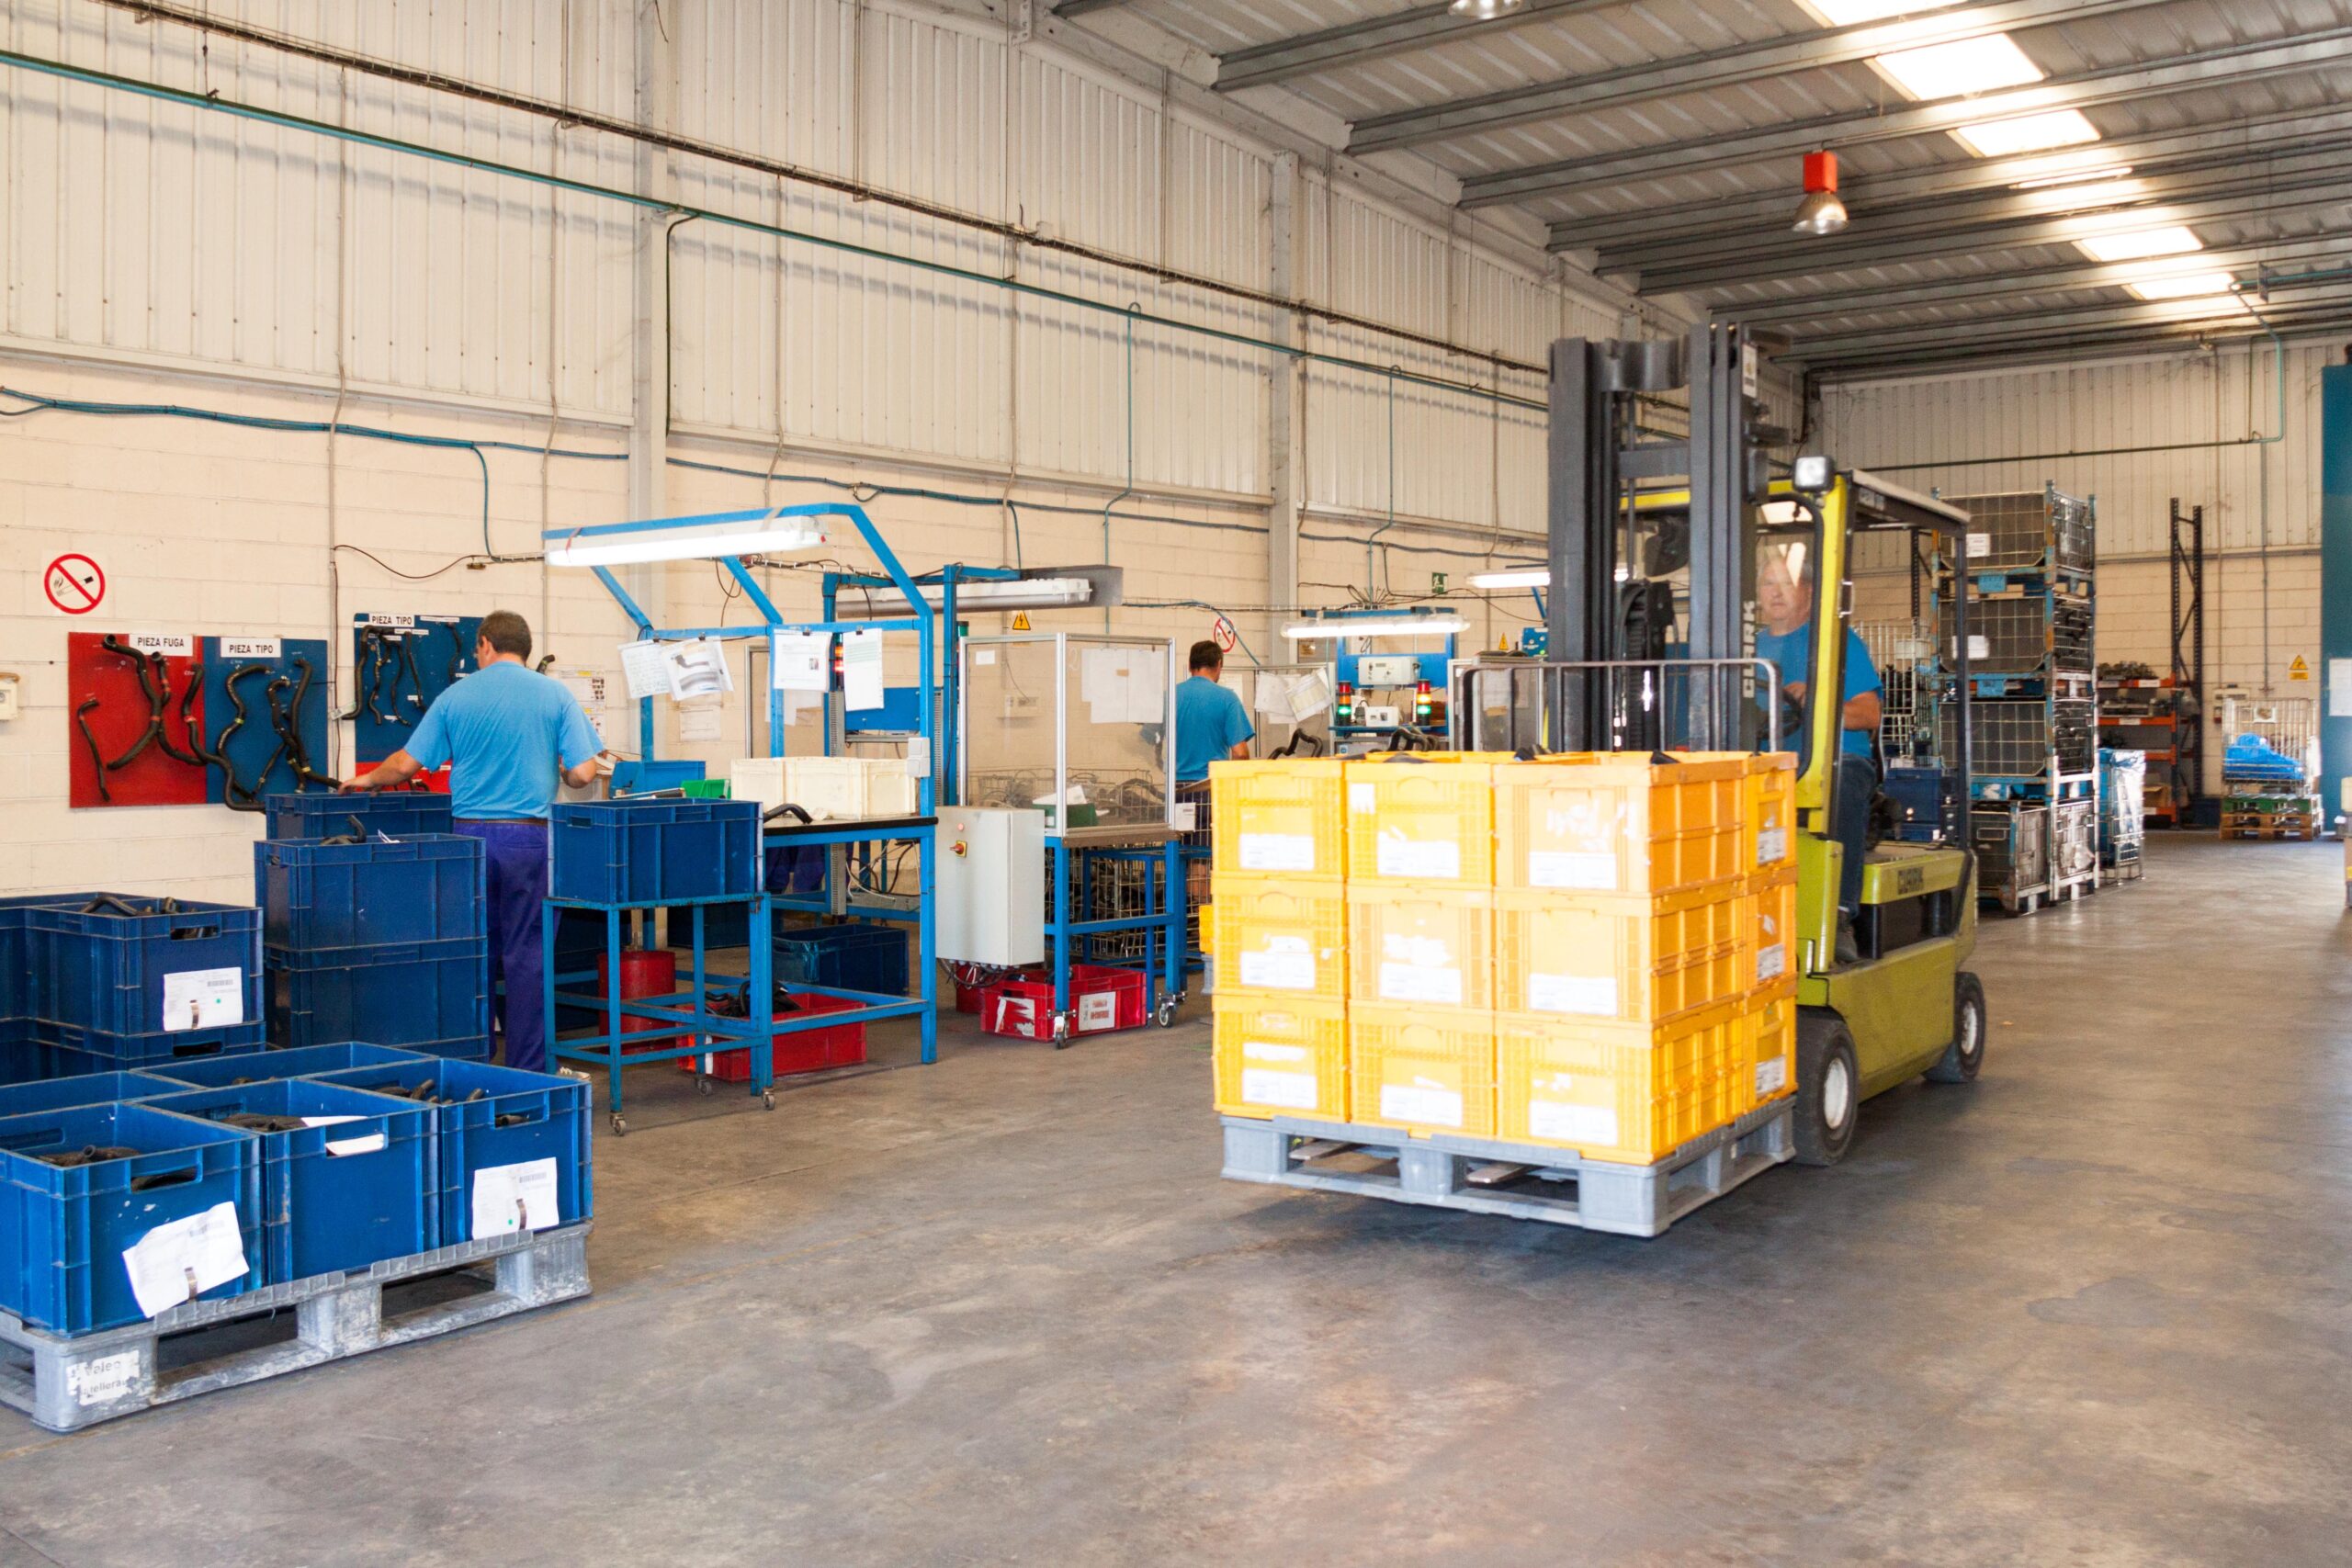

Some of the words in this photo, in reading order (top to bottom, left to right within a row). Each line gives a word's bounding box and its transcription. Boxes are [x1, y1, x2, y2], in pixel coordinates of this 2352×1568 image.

[371, 615, 392, 625] PIEZA
[395, 616, 413, 626] TIPO
[137, 637, 161, 647] PIEZA
[163, 637, 185, 647] FUGA
[229, 644, 252, 653] PIEZA
[255, 644, 274, 654] TIPO
[1743, 601, 1755, 698] CLARK
